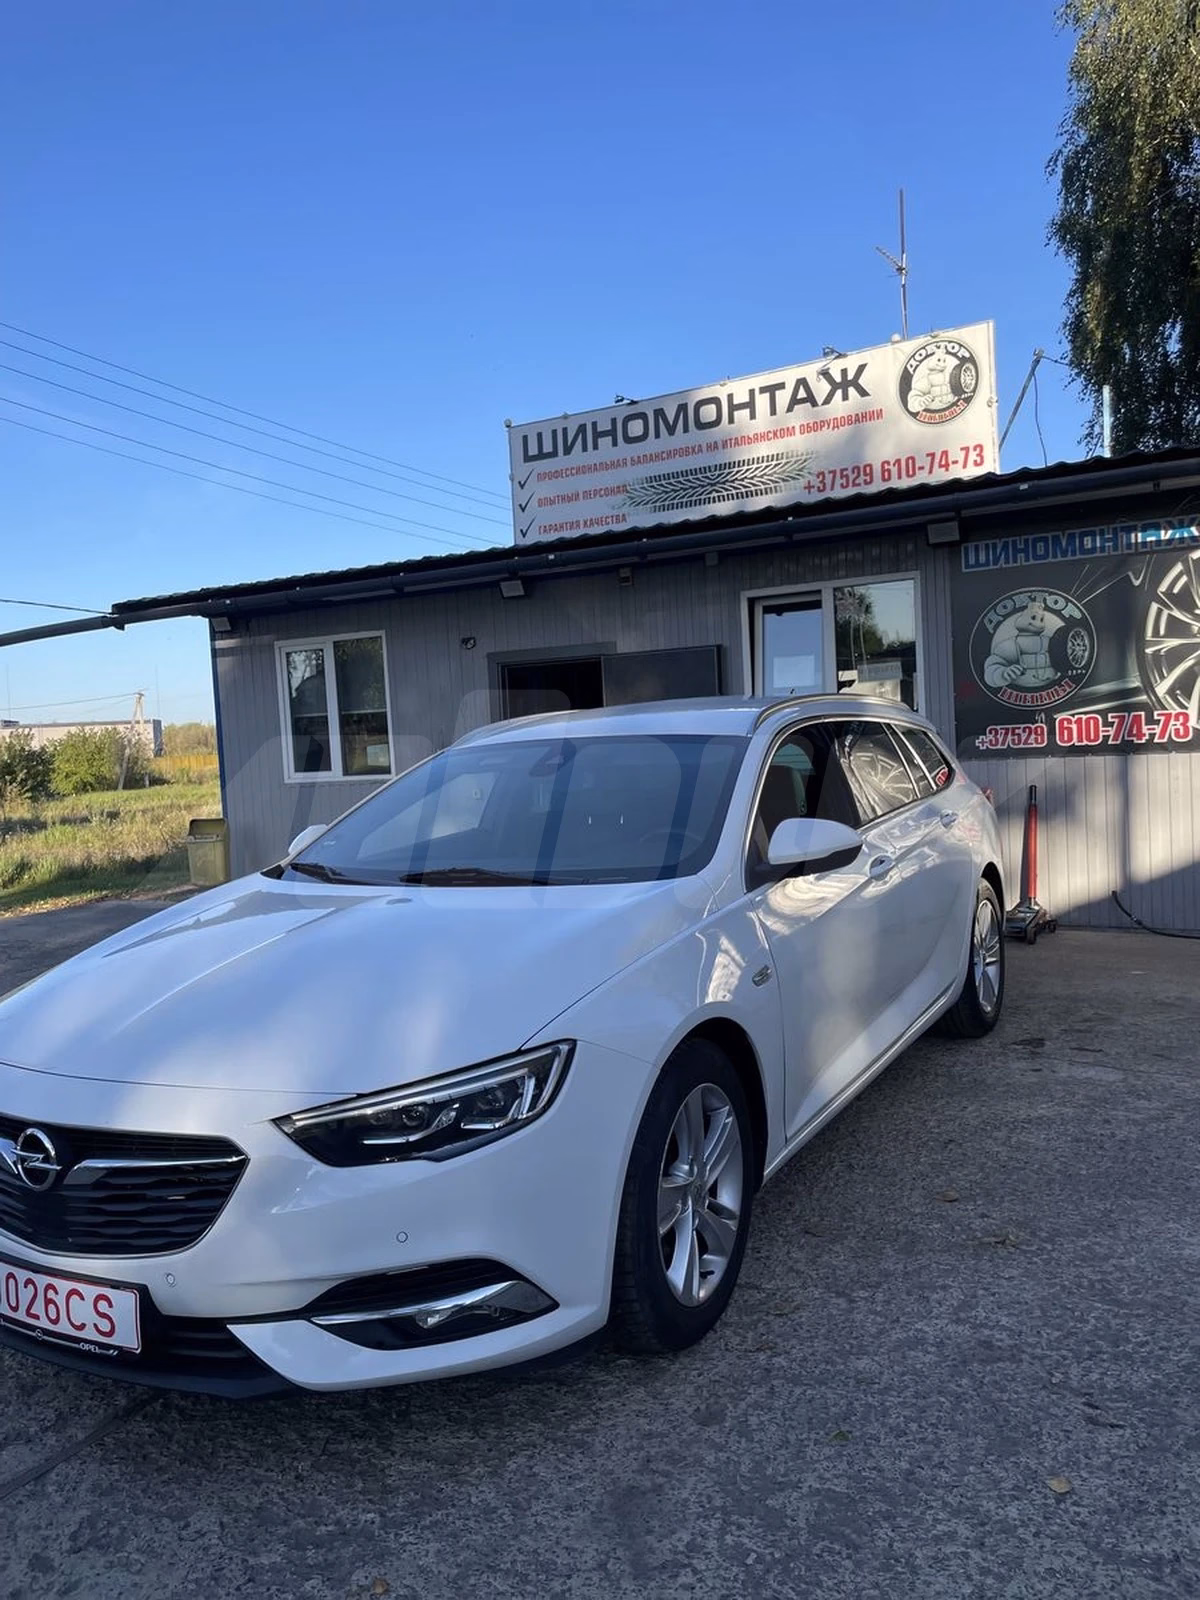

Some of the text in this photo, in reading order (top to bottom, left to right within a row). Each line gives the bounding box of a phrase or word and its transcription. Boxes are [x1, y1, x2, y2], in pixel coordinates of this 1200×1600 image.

[522, 363, 871, 463] ШИНОМОНТАЖ
[537, 409, 884, 482] ПРОФЕССИОНАЛЬНАЯ БАЛАНСИРОВКА НА ИТАЛЬЯНСКОМ ОБОРУДОВАНИИ
[803, 443, 985, 496] +37529 610-74-73
[537, 490, 580, 508] ОПЫТНЫЙ
[538, 513, 628, 535] ГАРАНТИЯ КАЧЕСТВА
[962, 514, 1200, 572] ШИНОМОНТАЖ
[976, 710, 1191, 750] +37529 610-74-73
[79, 1342, 100, 1353] OPEL
